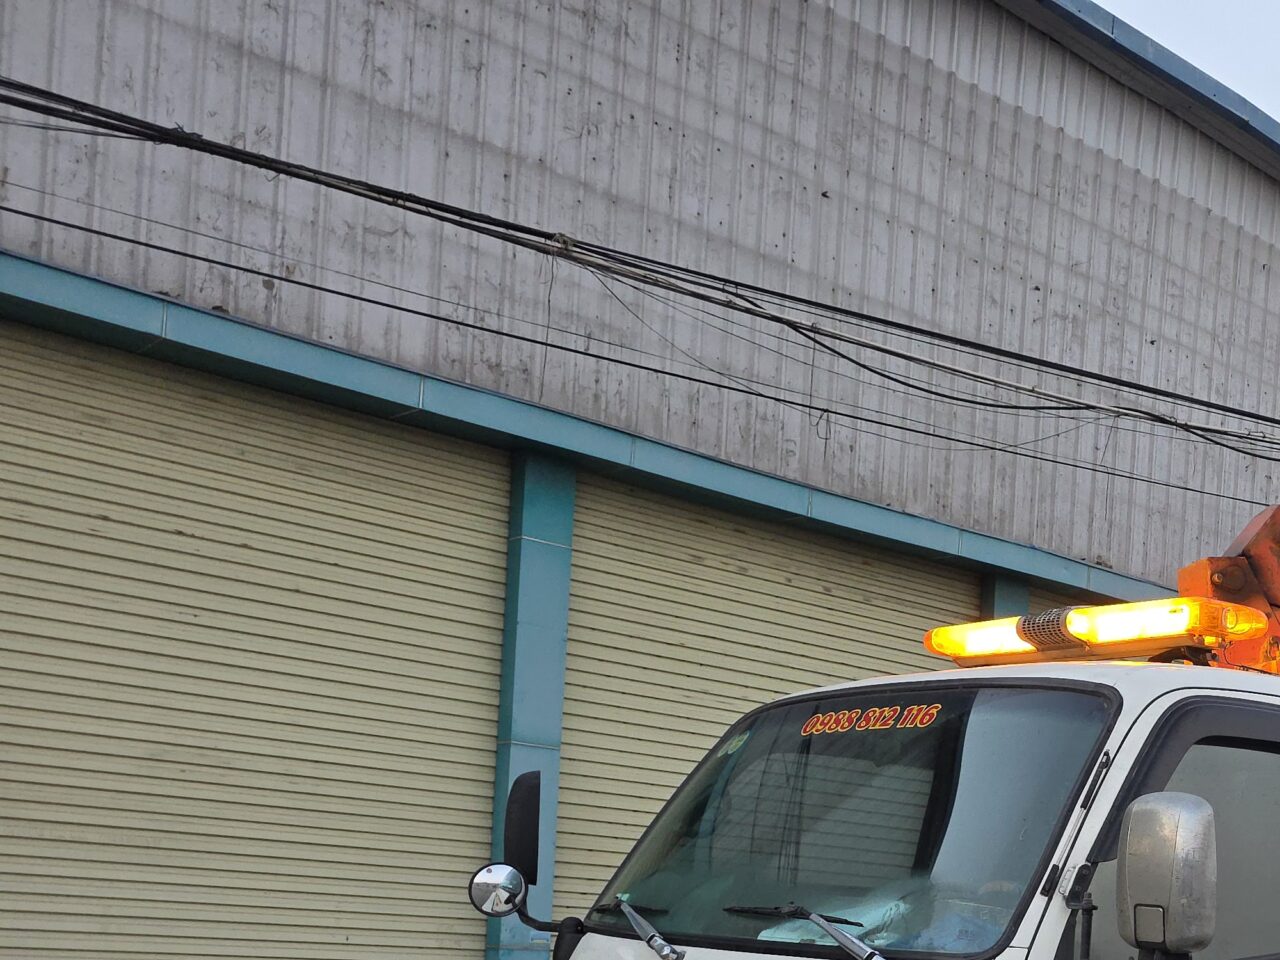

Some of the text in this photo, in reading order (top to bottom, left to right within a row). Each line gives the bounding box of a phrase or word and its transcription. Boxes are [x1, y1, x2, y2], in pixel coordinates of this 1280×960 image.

[801, 703, 942, 736] 0988 812 116
